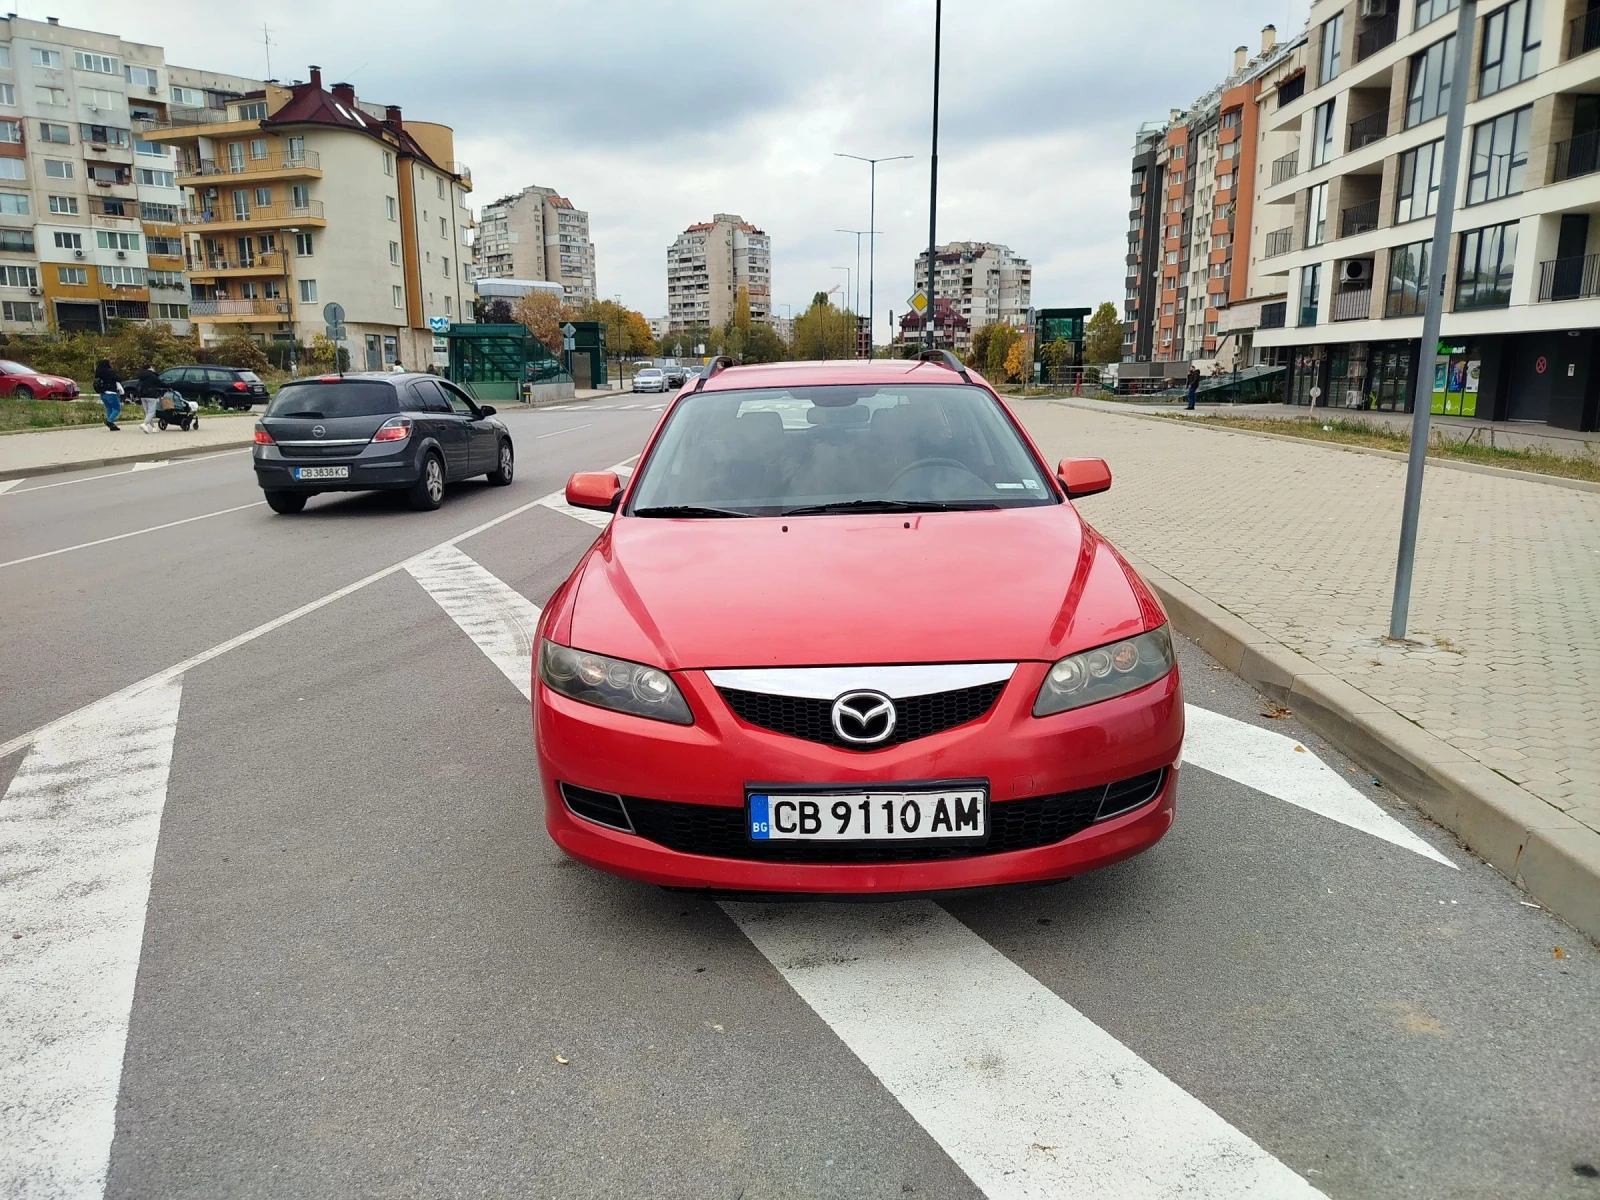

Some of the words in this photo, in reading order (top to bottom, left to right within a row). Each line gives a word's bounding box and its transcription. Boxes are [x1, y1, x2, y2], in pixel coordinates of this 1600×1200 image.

[301, 468, 313, 478] CB
[313, 468, 335, 478] 3838
[335, 467, 347, 477] KC
[774, 800, 822, 835] CB
[831, 799, 922, 835] 9110
[930, 796, 980, 833] AM
[752, 821, 768, 833] BG
